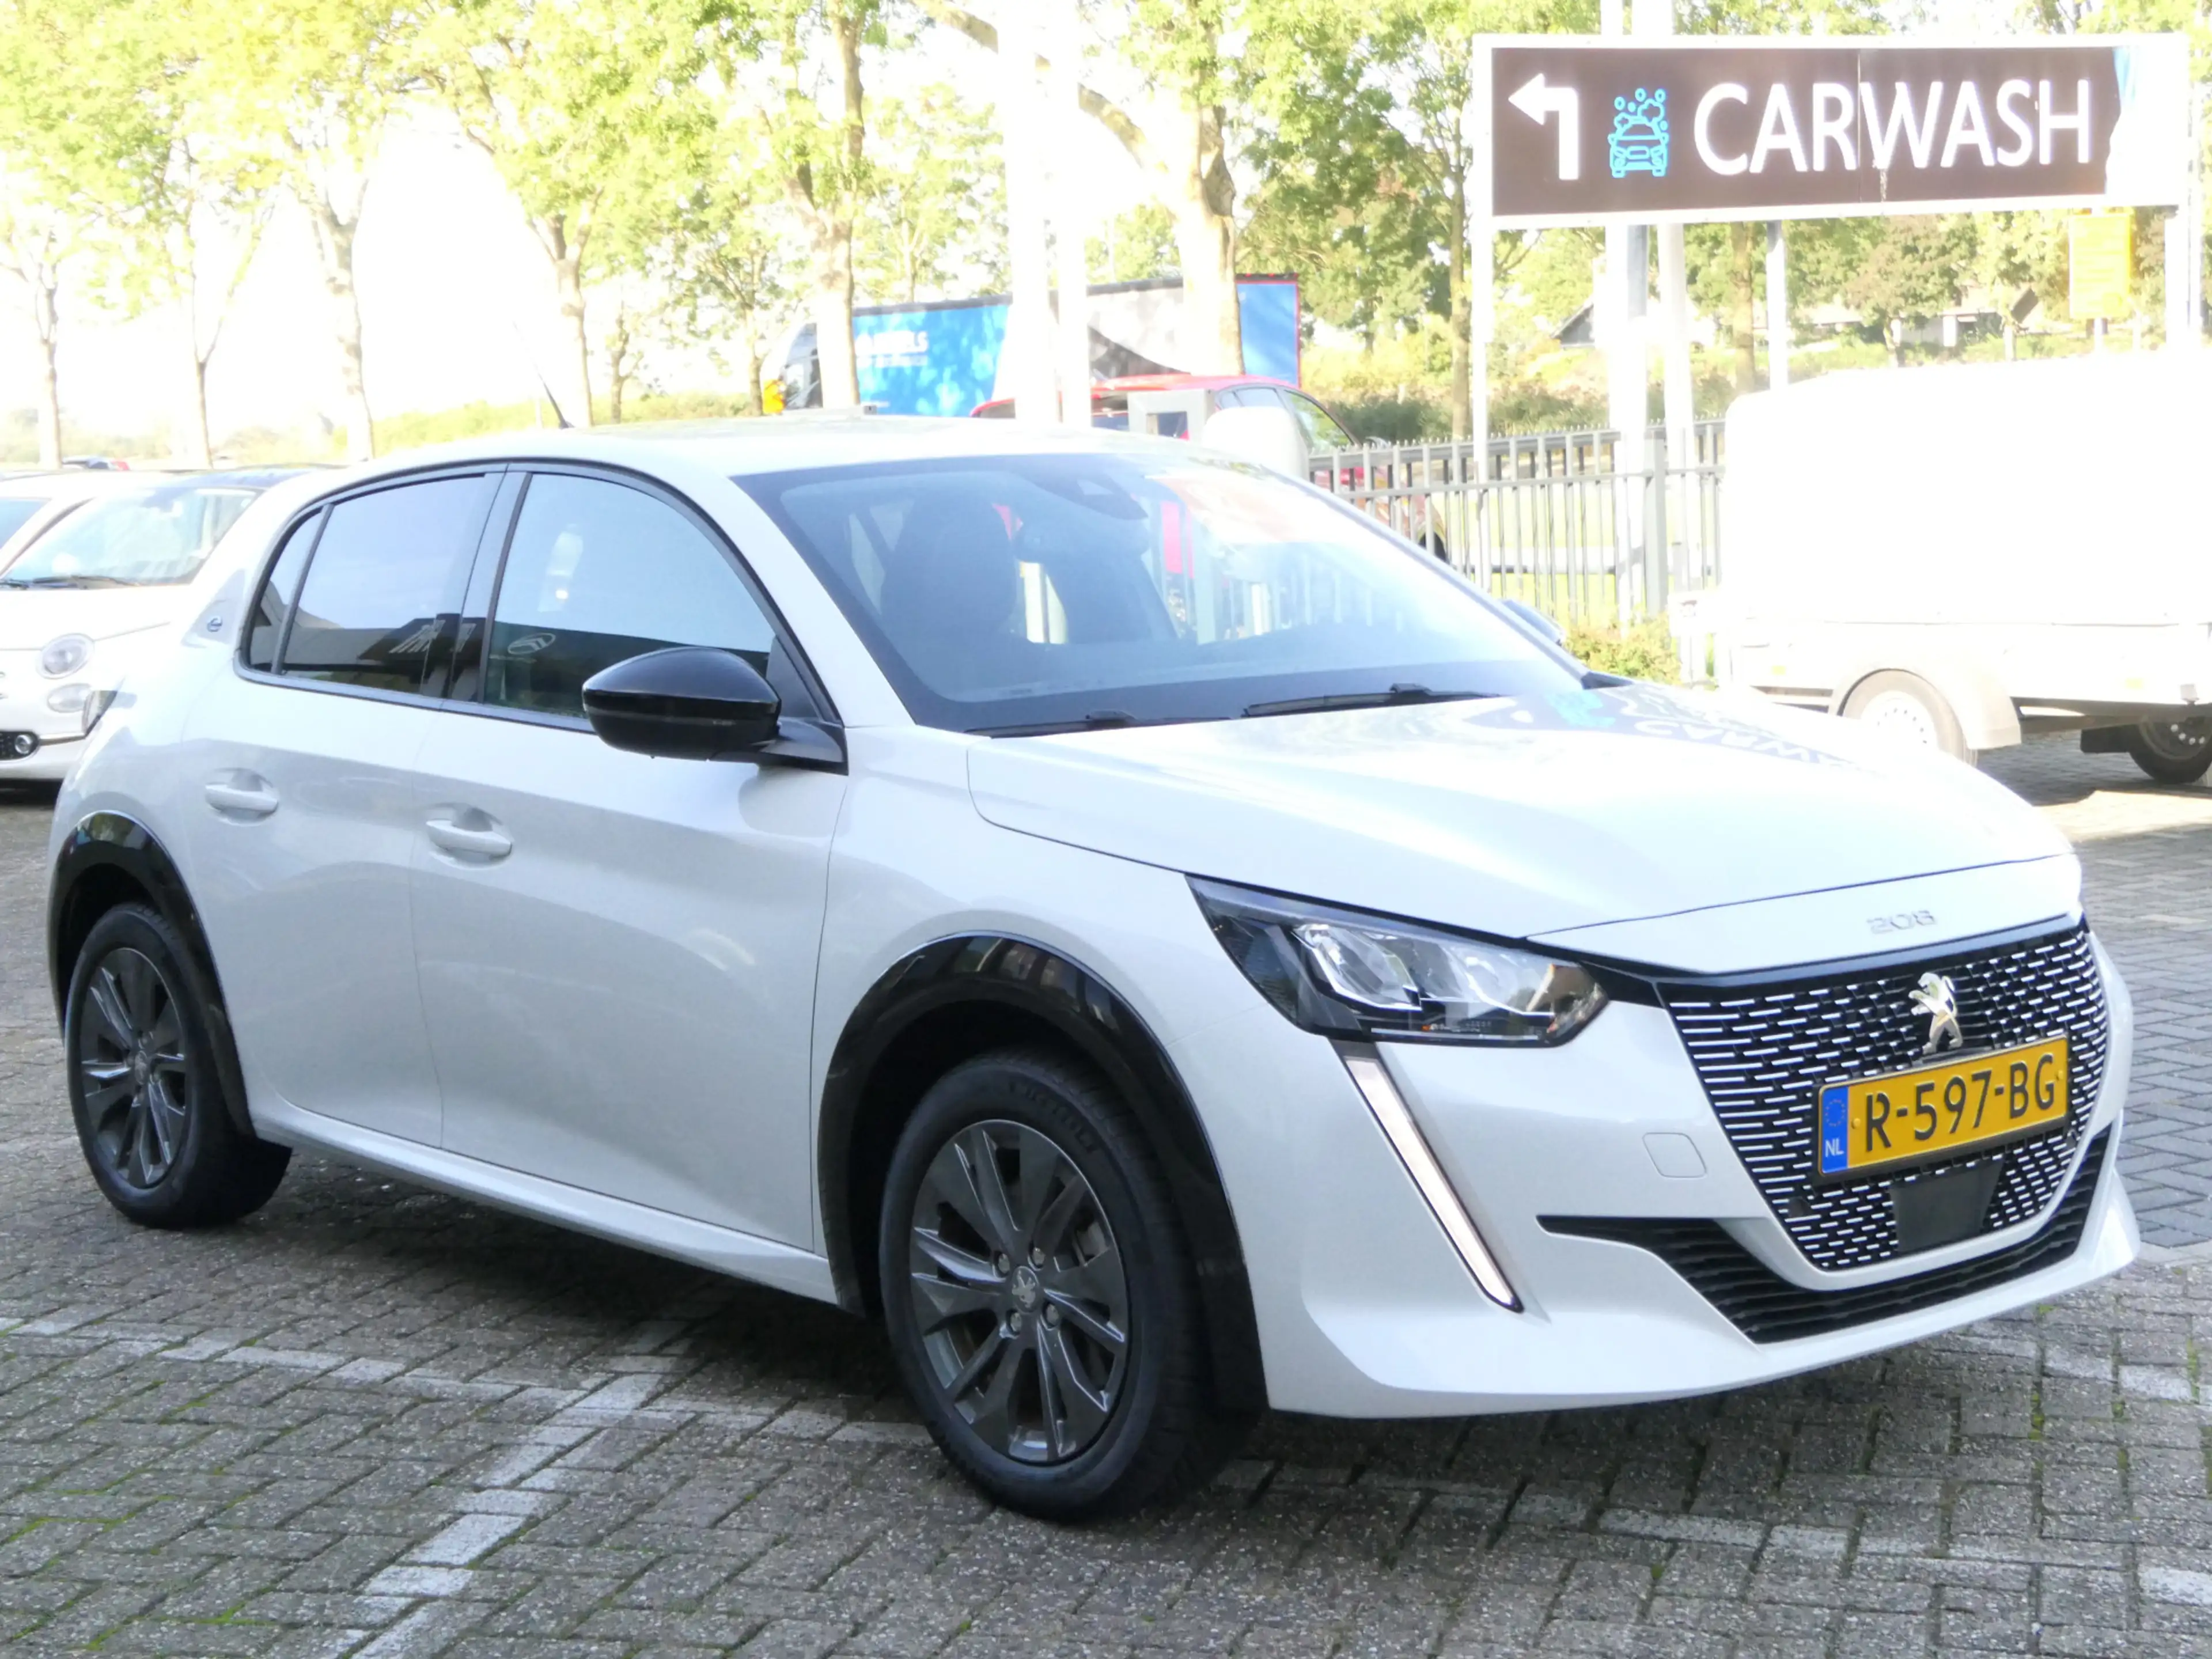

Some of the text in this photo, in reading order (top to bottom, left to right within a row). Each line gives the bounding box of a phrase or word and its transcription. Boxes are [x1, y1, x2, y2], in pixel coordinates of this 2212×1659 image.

[1693, 79, 2092, 175] CARWASH
[1866, 910, 1935, 934] 208
[1866, 1053, 2055, 1152] R-597-BG
[1825, 1138, 1843, 1157] NL
